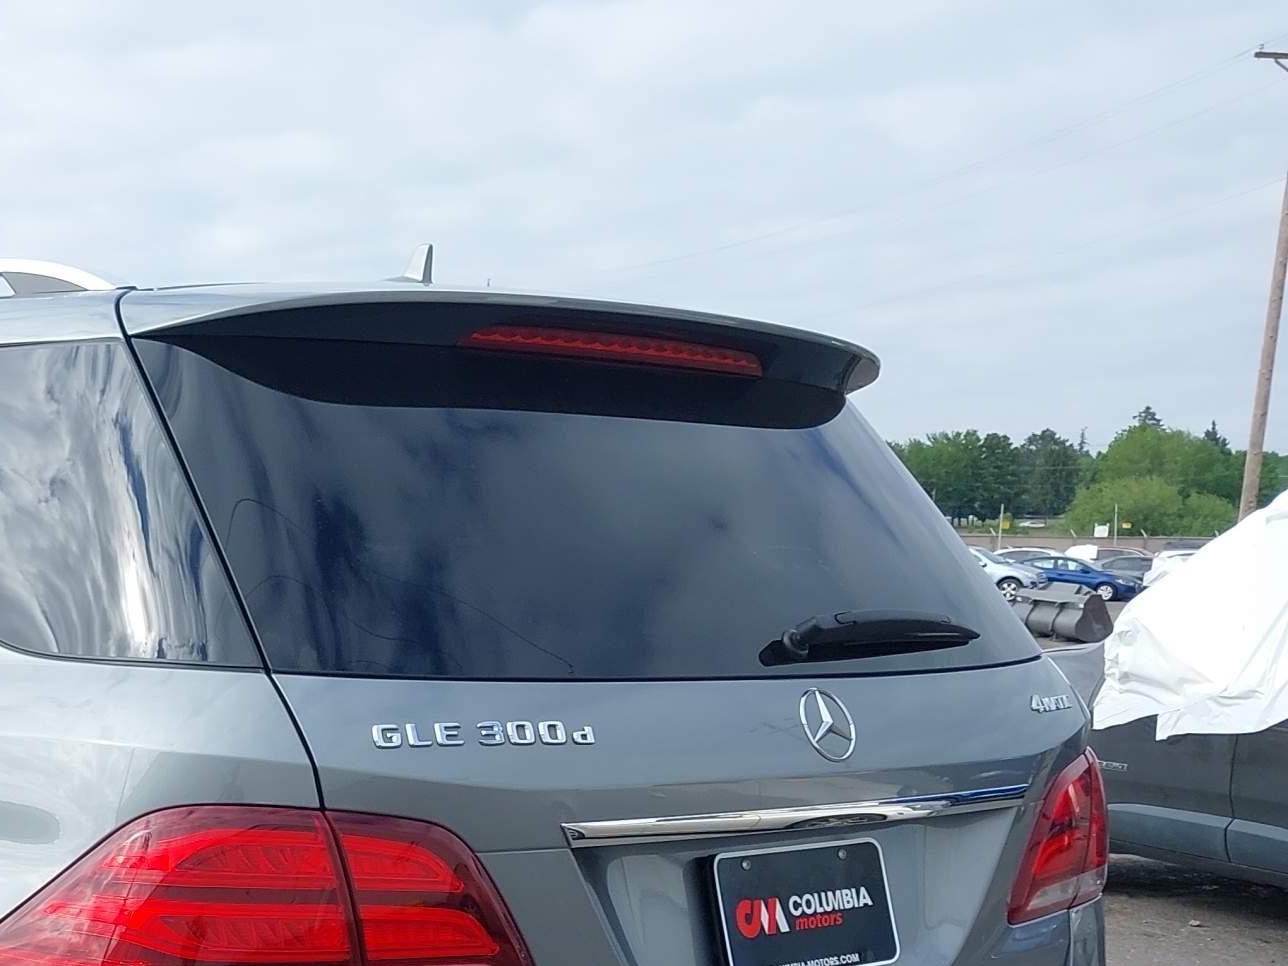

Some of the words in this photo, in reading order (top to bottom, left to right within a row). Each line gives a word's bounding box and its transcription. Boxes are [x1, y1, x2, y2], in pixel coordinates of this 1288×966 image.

[372, 722, 465, 748] GLE
[476, 720, 596, 746] 300d
[789, 887, 873, 916] COLUMBIA
[796, 913, 843, 930] motors
